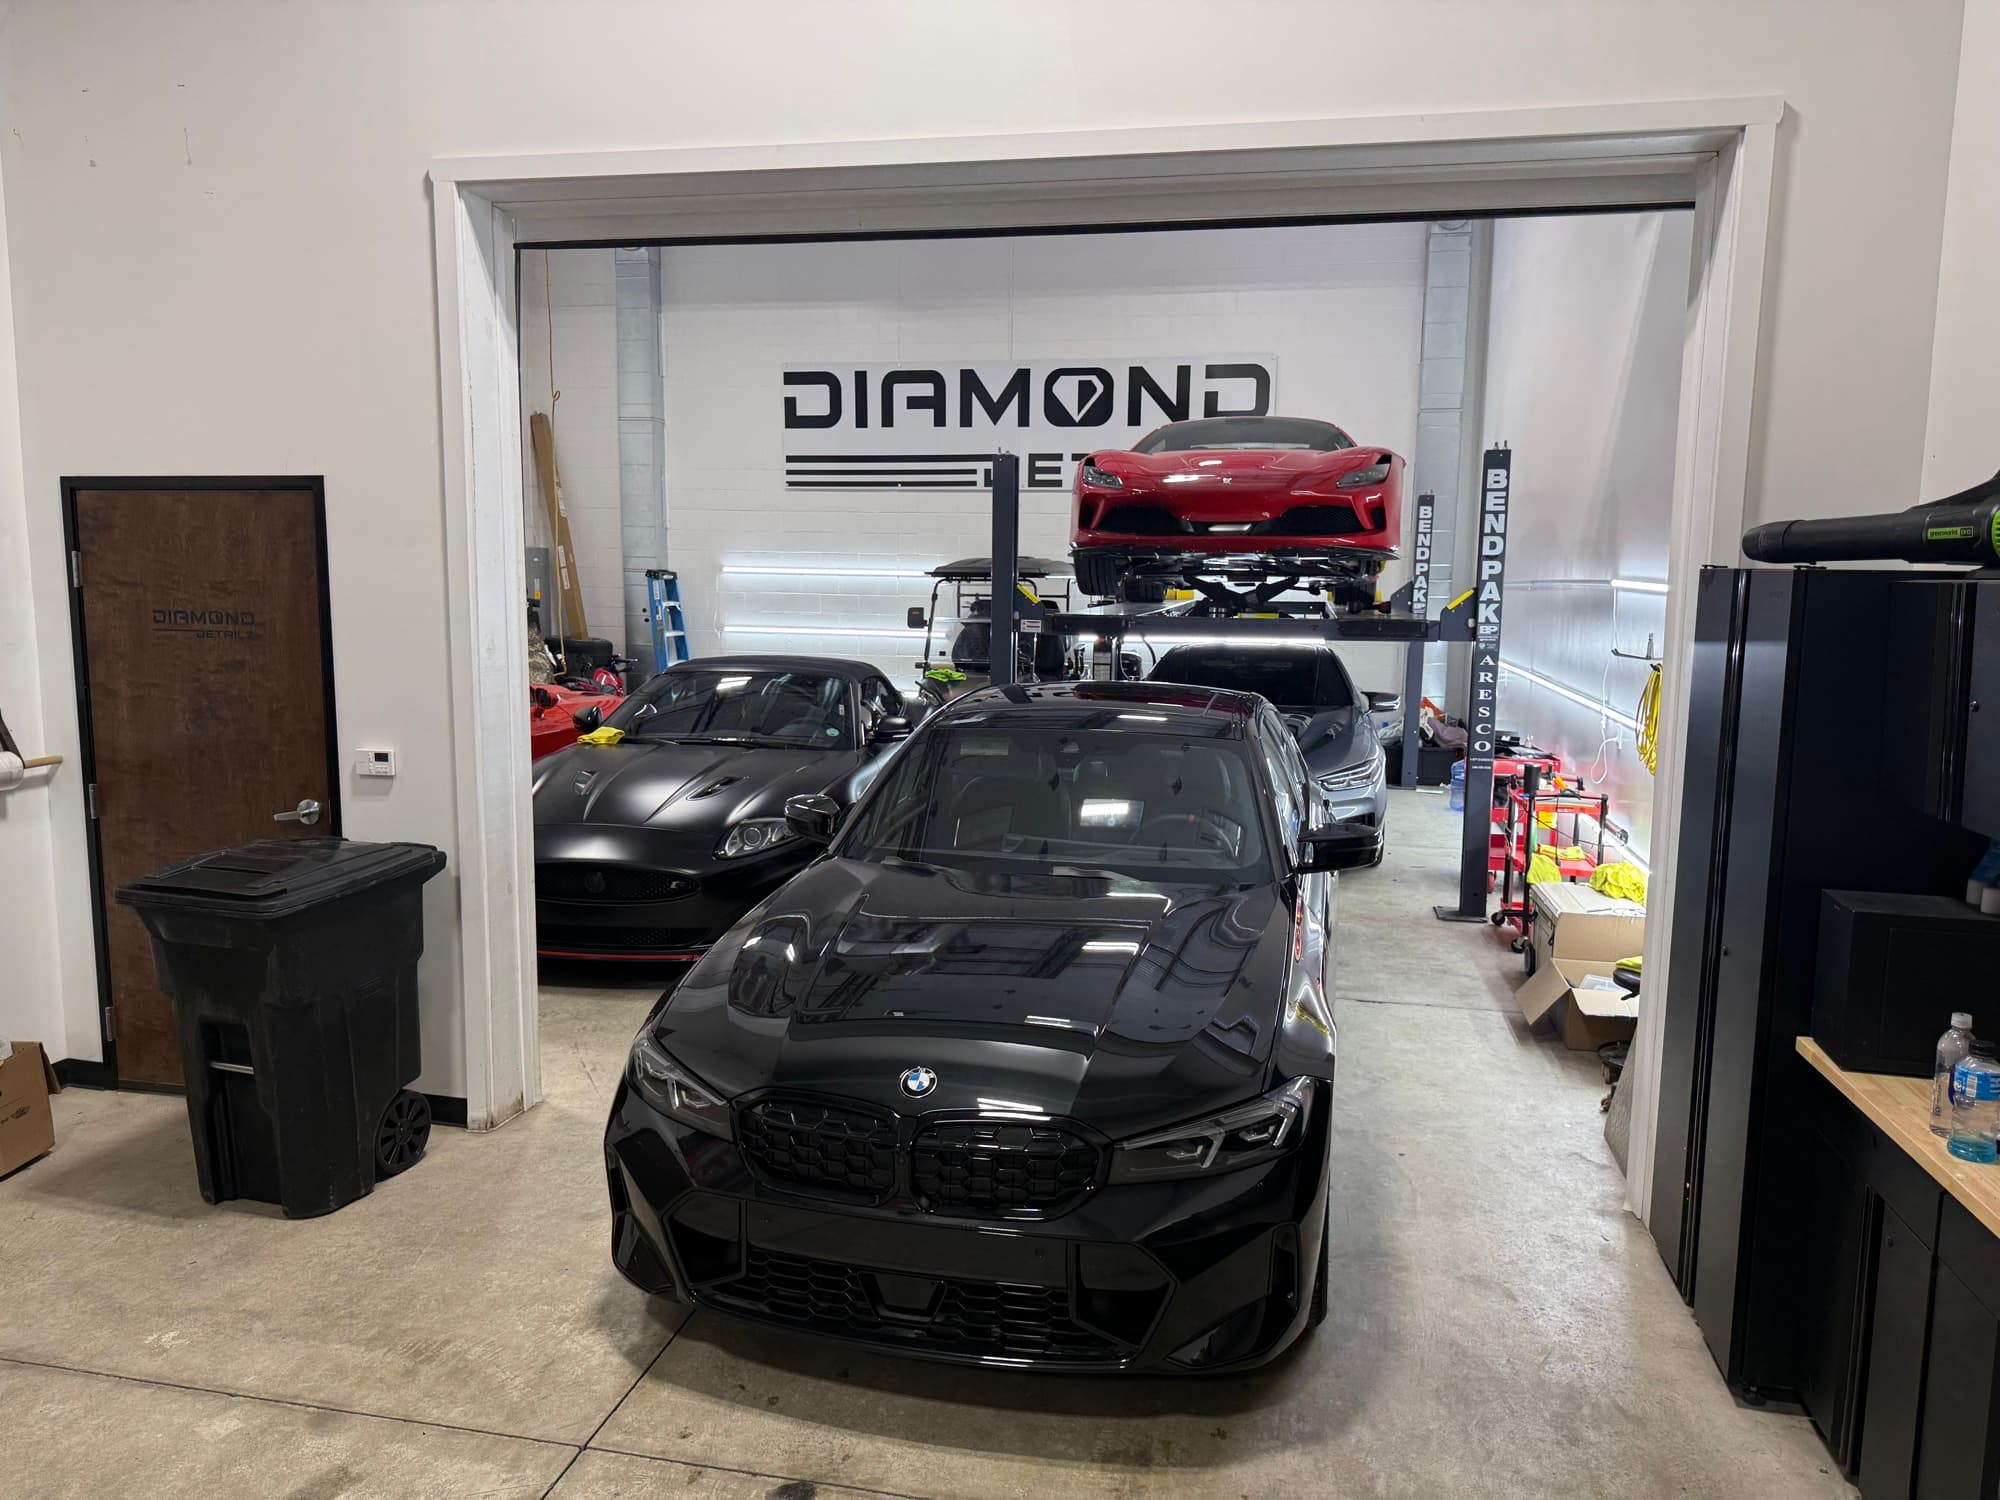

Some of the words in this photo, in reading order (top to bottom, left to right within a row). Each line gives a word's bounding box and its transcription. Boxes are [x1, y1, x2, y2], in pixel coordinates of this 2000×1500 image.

[783, 364, 1270, 429] DIAMOND
[1412, 506, 1432, 602] BENDPAK
[1478, 469, 1508, 623] BENDPAK
[152, 610, 255, 625] DIAMOND
[1474, 655, 1496, 752] ARESCO
